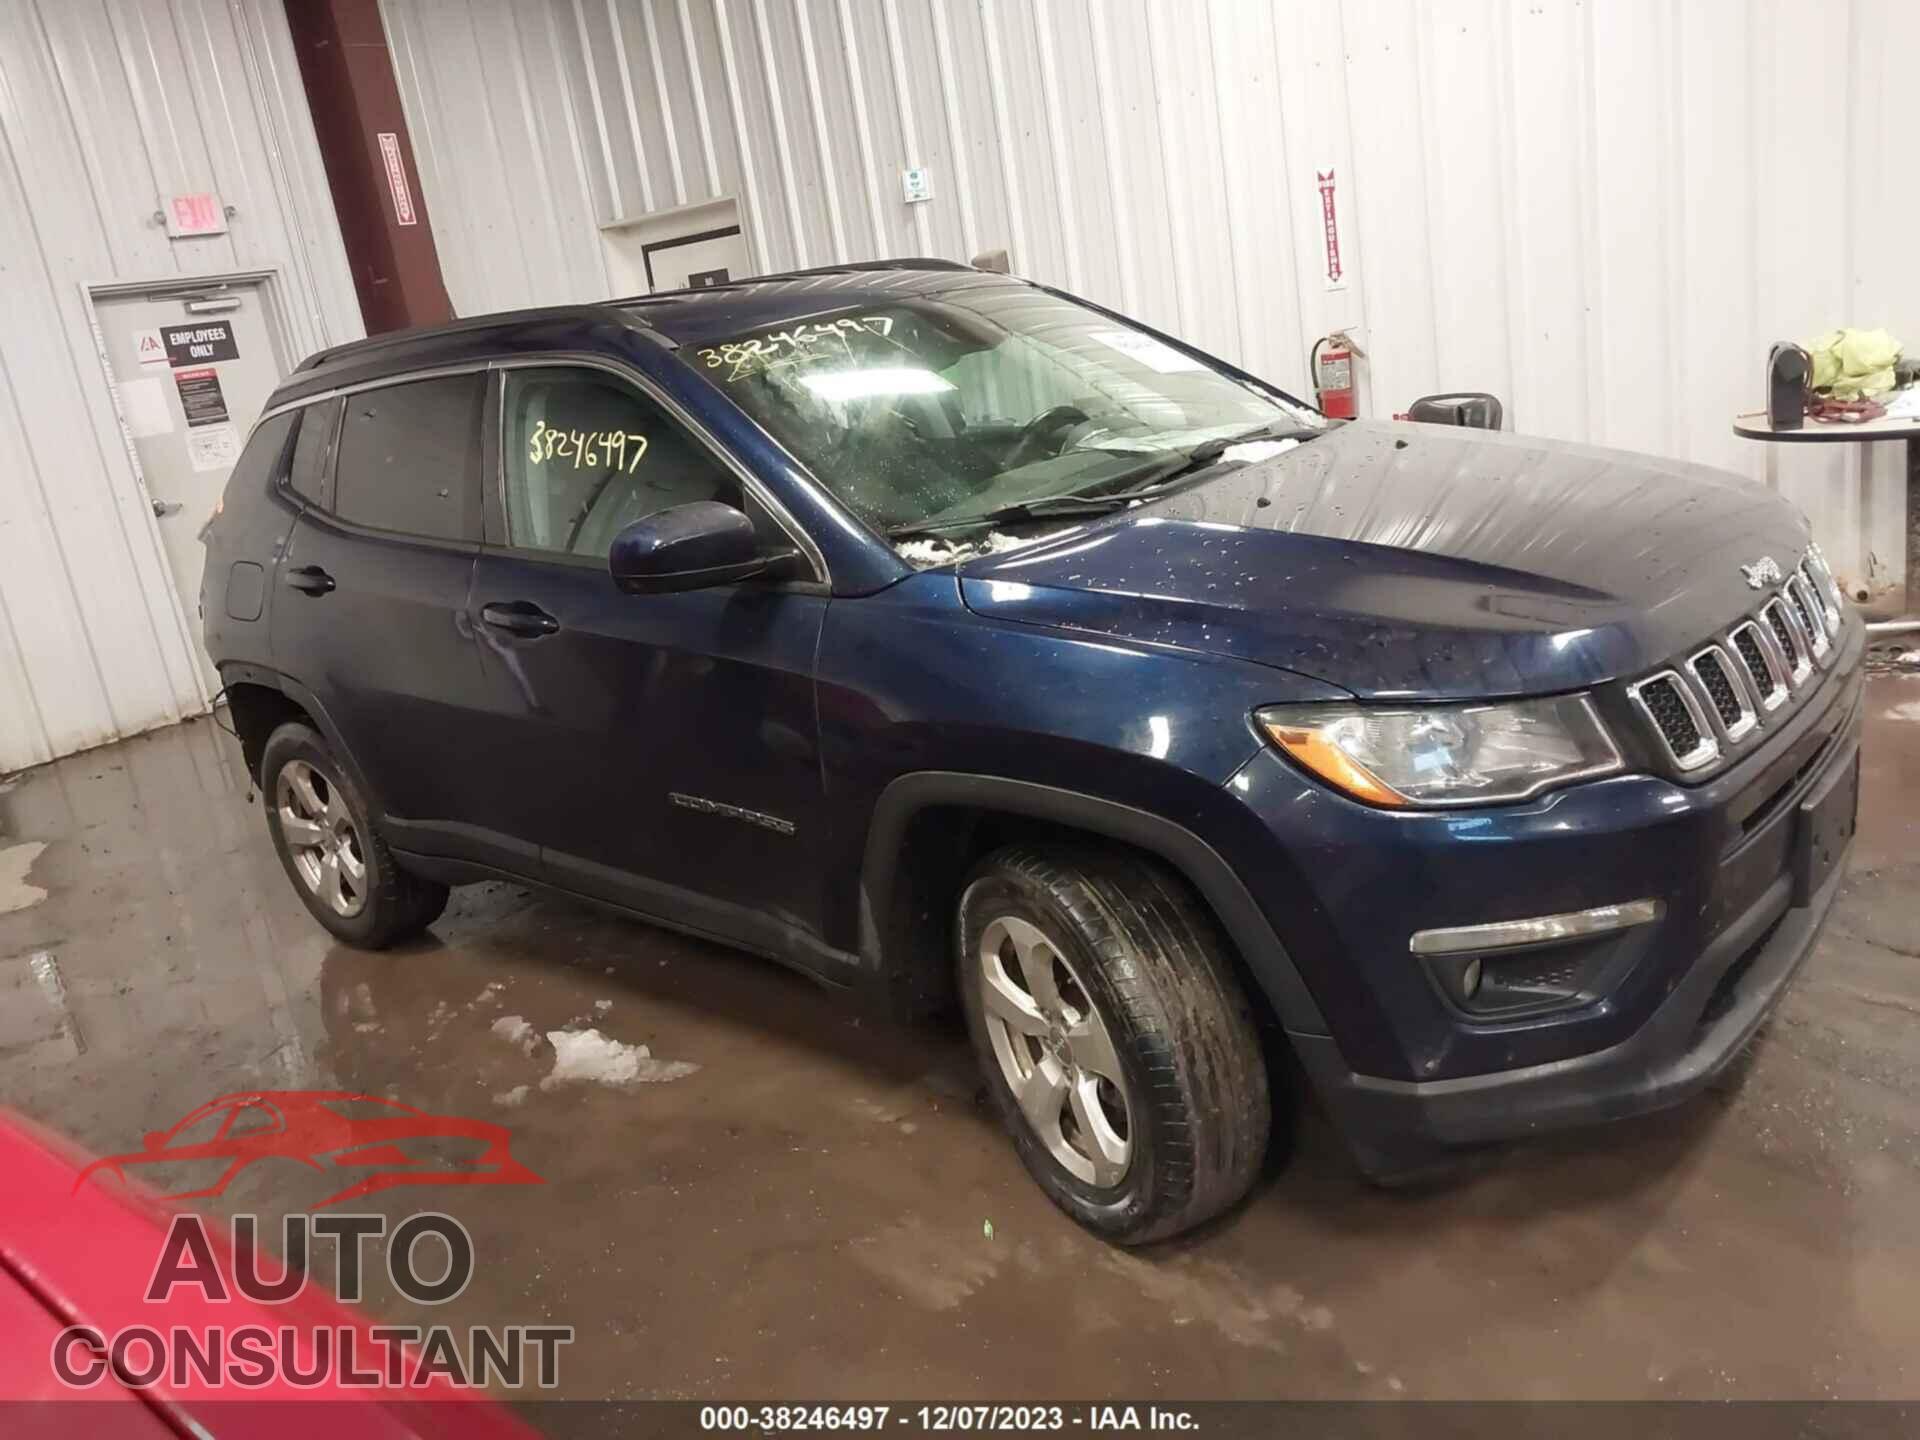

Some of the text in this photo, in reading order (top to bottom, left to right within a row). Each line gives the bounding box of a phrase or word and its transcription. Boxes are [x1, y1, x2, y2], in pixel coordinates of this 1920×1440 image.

[171, 193, 216, 228] EXIT
[169, 327, 226, 346] EMPLOYEES
[190, 343, 213, 358] ONLY
[697, 316, 894, 368] 38246497
[530, 420, 648, 474] 38246497
